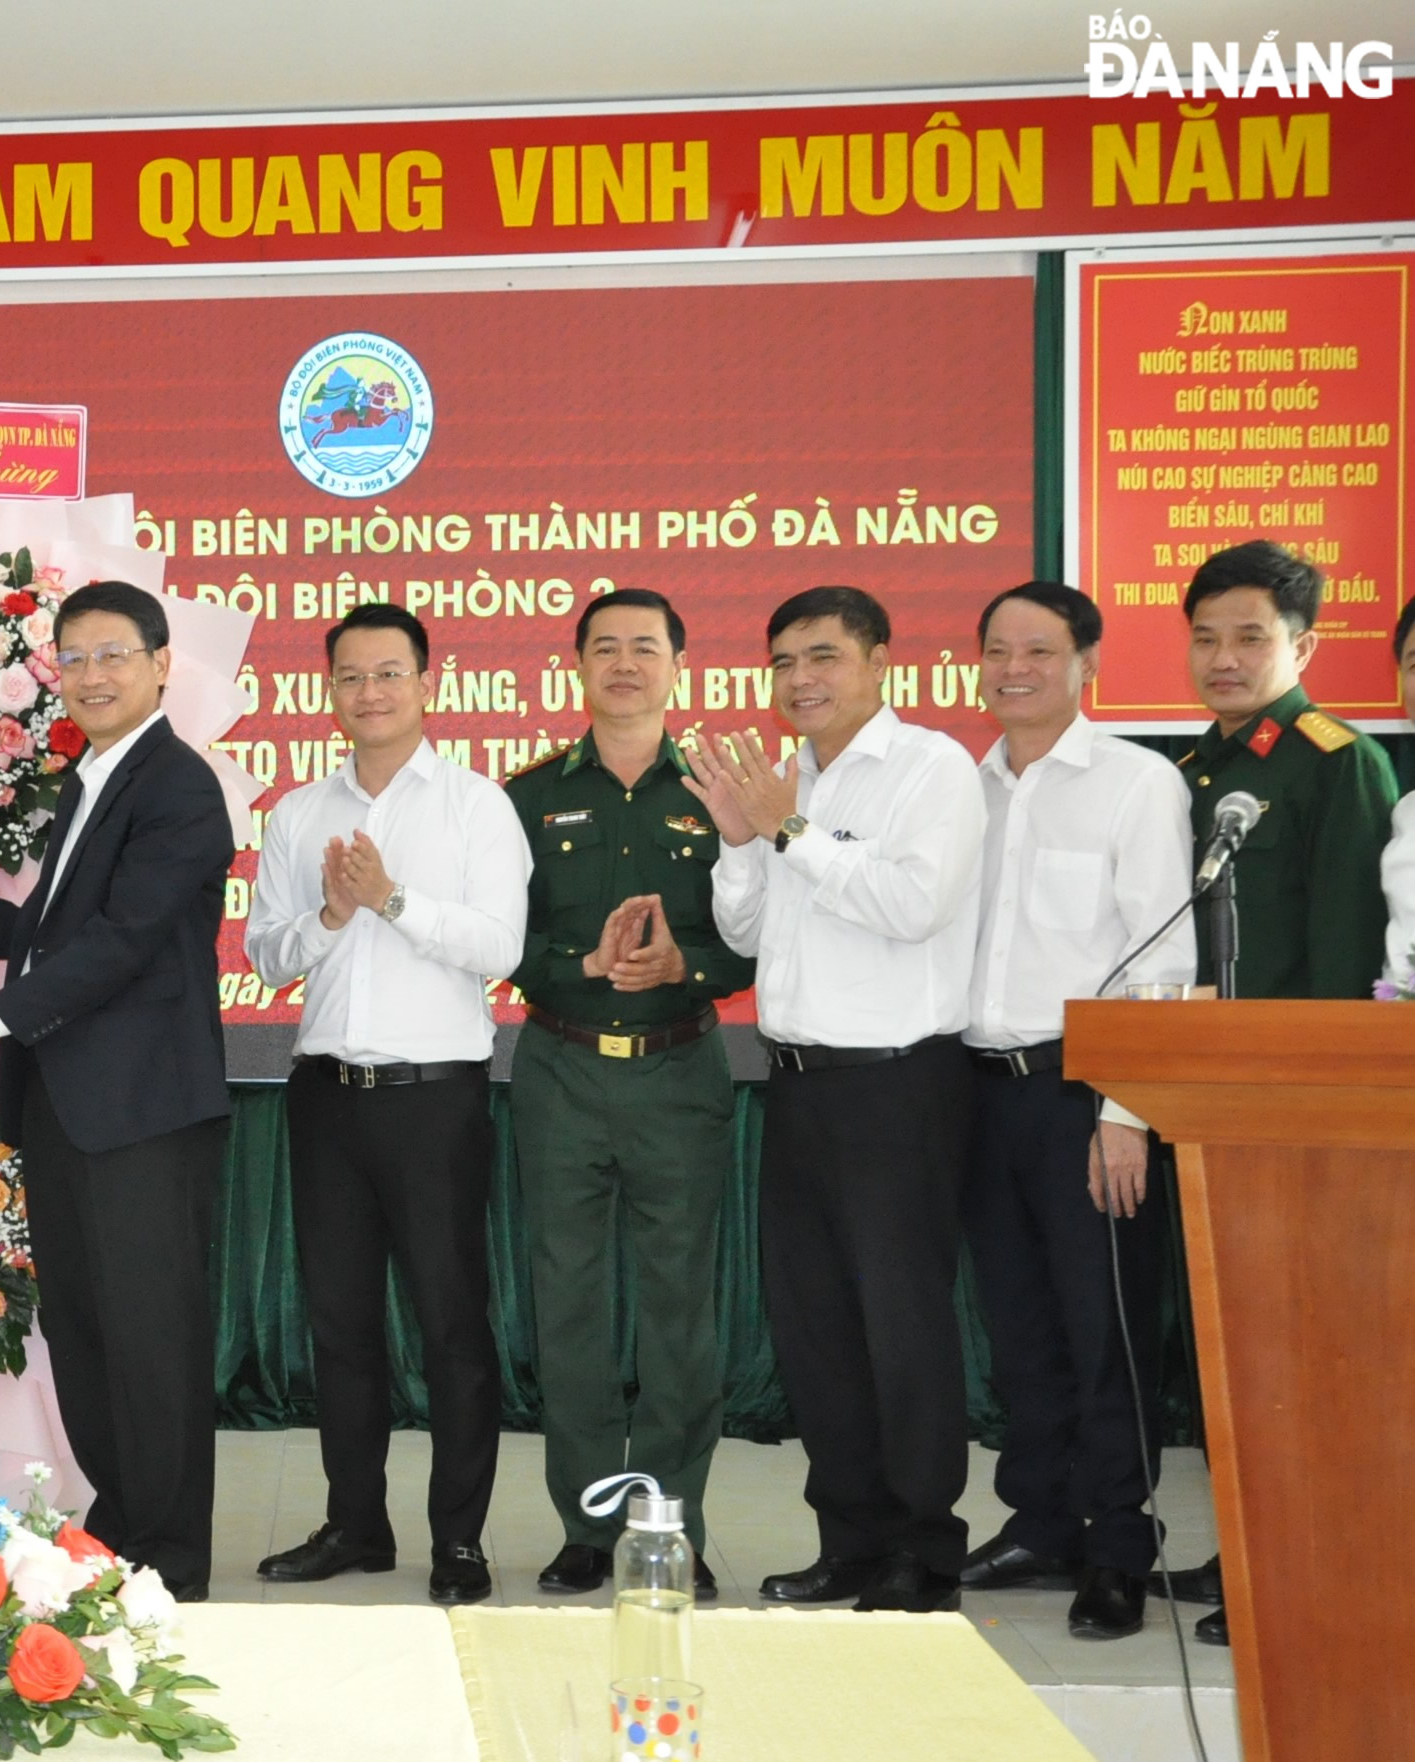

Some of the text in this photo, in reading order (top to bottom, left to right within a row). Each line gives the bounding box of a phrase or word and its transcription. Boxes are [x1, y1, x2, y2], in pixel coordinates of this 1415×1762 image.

[138, 149, 443, 248] QUANG
[490, 139, 709, 227] VINH
[760, 111, 1044, 219] MUÔN
[1091, 101, 1331, 208] NĂM
[1176, 301, 1286, 336] NON XANH
[316, 342, 340, 363] BIÊN
[343, 339, 383, 354] PHÒNG
[386, 347, 408, 368] VIỆT
[405, 367, 424, 396] NAM
[1139, 342, 1358, 374] NƯỚC BIẾC TRÙNG TRÙNG
[1175, 385, 1206, 412] GIỮ
[1209, 384, 1240, 411] GÌN
[1271, 378, 1319, 413] QUỐC
[1107, 429, 1126, 452] TA
[1131, 424, 1190, 451] KHÔNG
[1195, 427, 1236, 455] NGẠI
[1308, 424, 1350, 448] GIAN
[1355, 423, 1390, 447] LAO
[1118, 461, 1378, 494] NÚI CAO SỰ NGHIỆP CÀNG CAO
[192, 508, 287, 556] BIÊN
[304, 505, 471, 554] PHÒNG
[485, 501, 641, 552] THÀNH
[658, 492, 758, 549] PHỐ
[772, 496, 841, 547] ĐÀ
[856, 488, 999, 545] NẴNG
[1214, 499, 1254, 530] SÂU,
[1259, 498, 1289, 527] CHÍ
[1294, 498, 1324, 526] KHÍ
[1153, 543, 1172, 566] TA
[1303, 537, 1339, 565] SÂU
[406, 568, 575, 618] PHÒNG
[1114, 582, 1140, 606] THI
[1145, 581, 1178, 605] ĐUA
